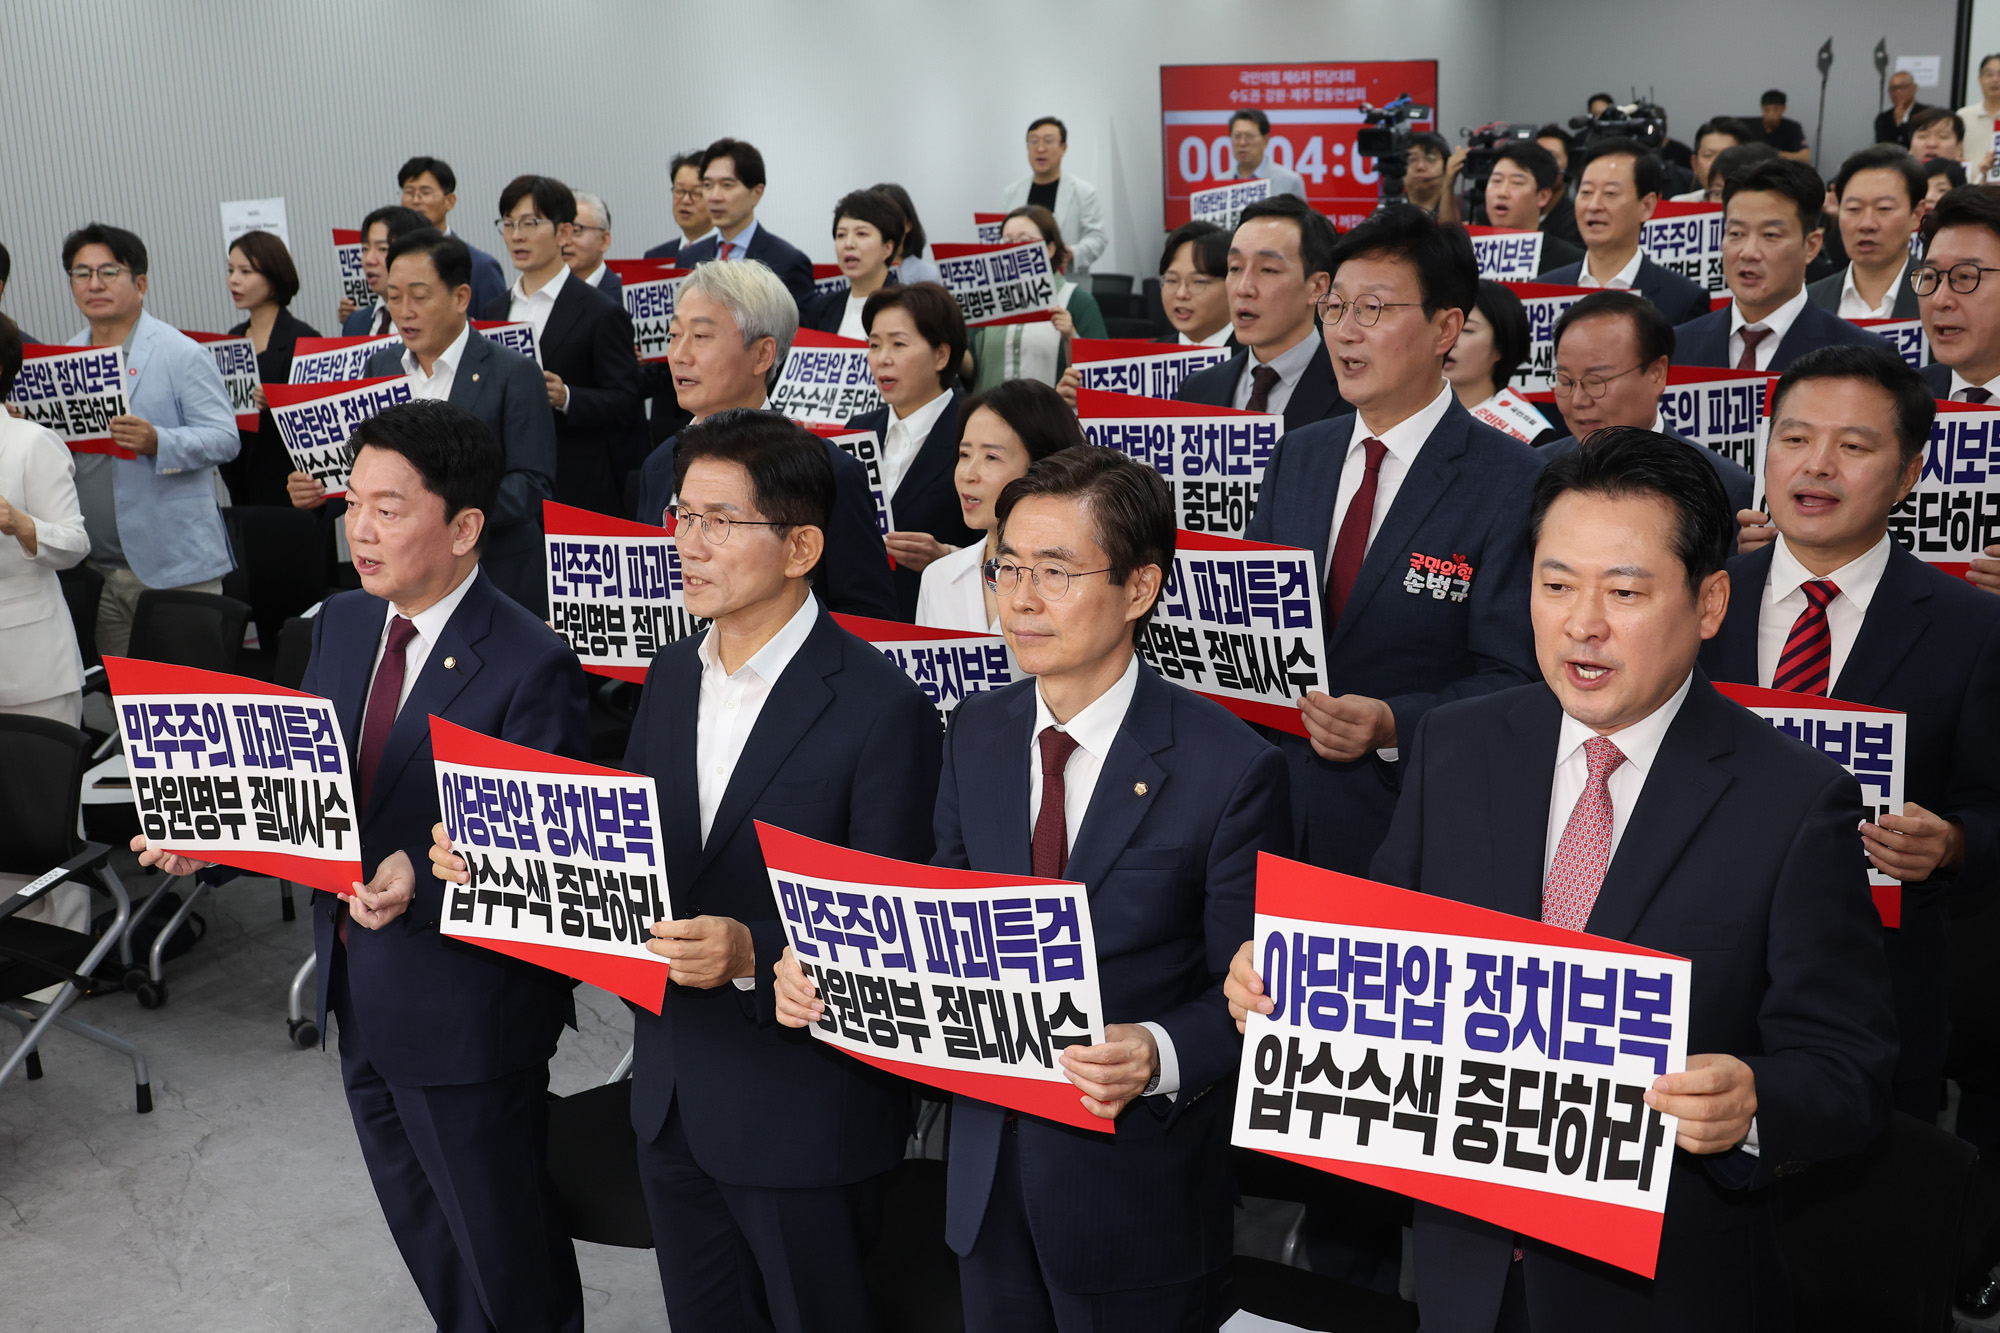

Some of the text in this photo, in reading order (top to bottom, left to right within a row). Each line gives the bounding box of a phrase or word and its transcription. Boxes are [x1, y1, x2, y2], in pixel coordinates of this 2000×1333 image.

[339, 247, 364, 277] 민주
[939, 257, 990, 291] 민주주의
[989, 245, 1048, 283] 파괴특검
[1474, 237, 1537, 275] 정치보복
[626, 282, 676, 320] 야당탄압
[954, 276, 1053, 320] 원명부 절대사수
[5, 351, 122, 403] 당탄압 정치보복
[224, 377, 257, 409] 대사수
[785, 351, 846, 384] 야당탄압
[277, 401, 345, 450] 야당탄압
[773, 384, 889, 420] 압수수색 중단하
[1180, 422, 1277, 477] 정치보복
[1920, 419, 2000, 485] 치보
[1182, 480, 1260, 533] 중단하
[550, 541, 684, 600] 민주주의 파괴특
[1189, 559, 1313, 630] 파괴특검
[1402, 567, 1471, 603] 손범규
[1410, 552, 1474, 582] 국민의힘
[553, 601, 629, 658] 당원명부
[910, 644, 1012, 705] 정치보복
[1203, 629, 1319, 699] 절대사수
[122, 702, 343, 775] 민주주의 파괴특검
[135, 775, 352, 851] 당원명부 절대사수
[442, 771, 656, 867] 야당탄압 정치보복
[449, 849, 666, 946] 압수수색 중단하라
[777, 879, 1086, 984] 민주주의 파괴특검
[798, 959, 1093, 1069] 당원명부 절대사수
[1262, 930, 1674, 1076] 야당탄압 정치보복
[1248, 1033, 1666, 1192] 압수수색 중단하라
